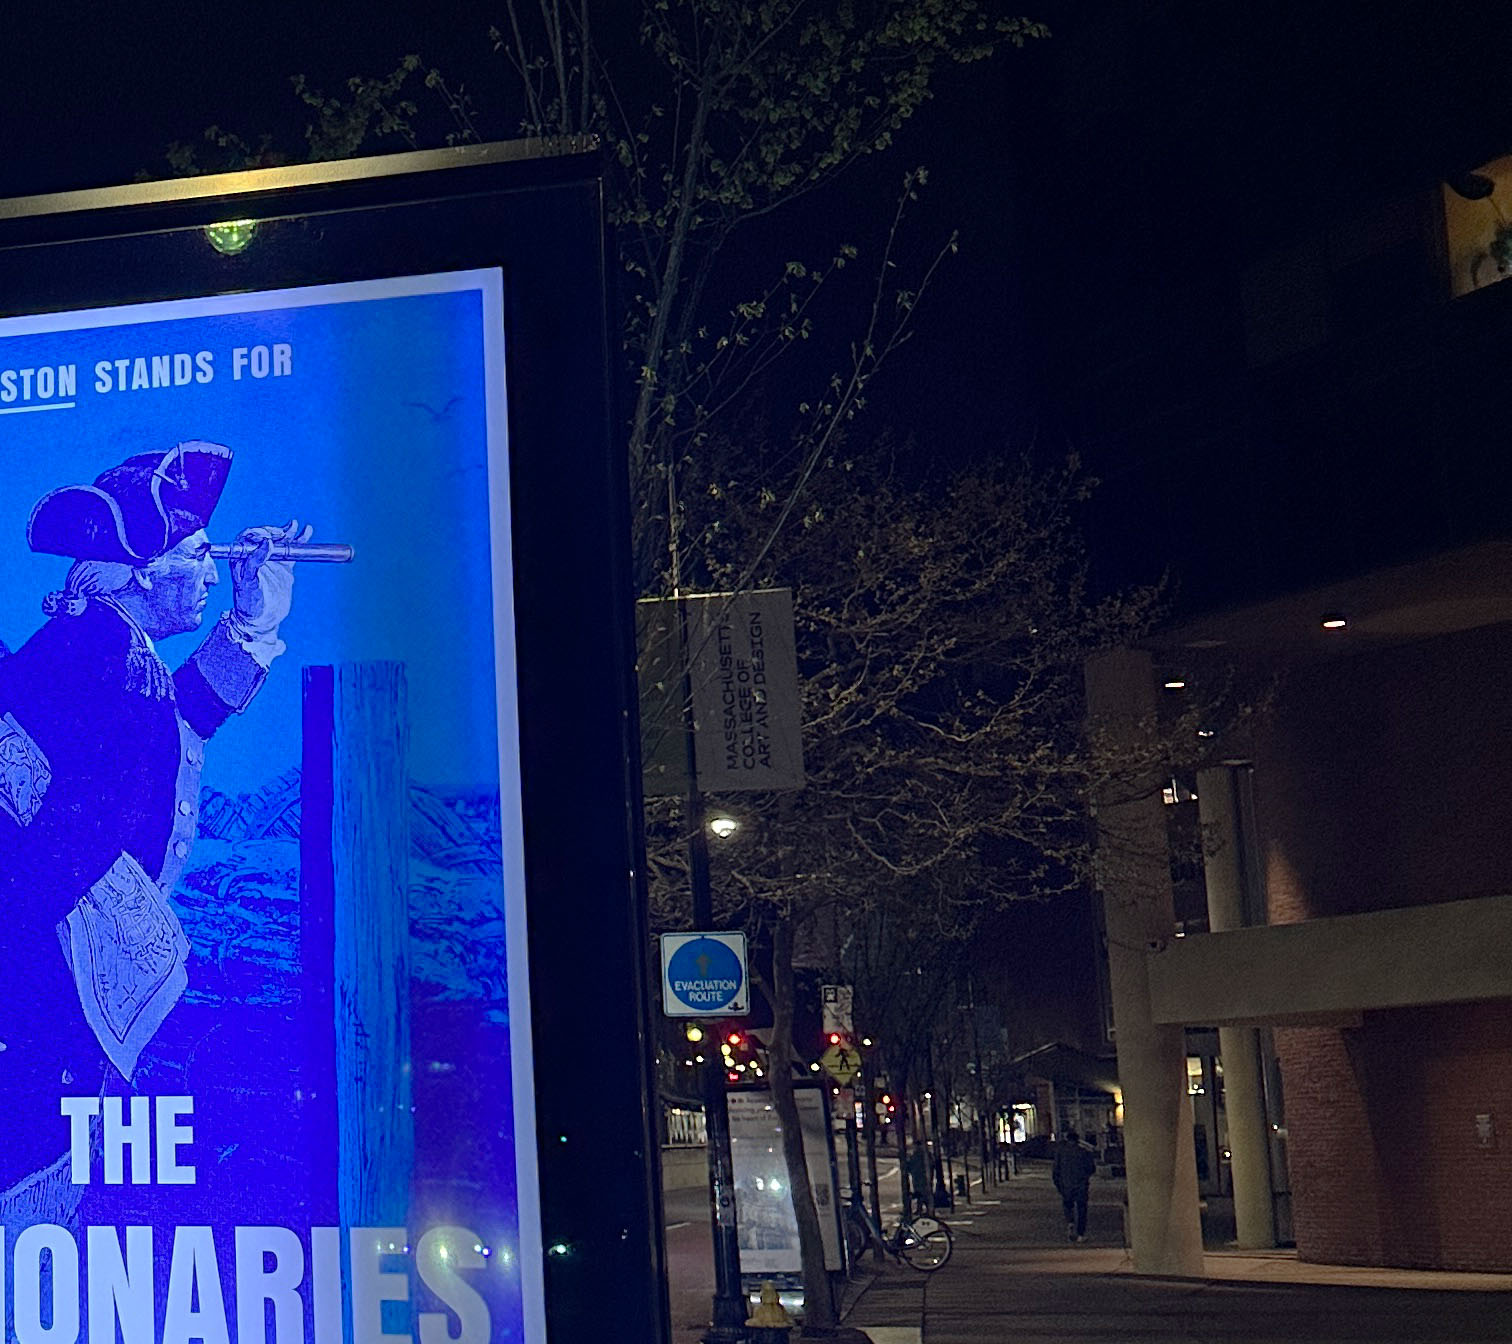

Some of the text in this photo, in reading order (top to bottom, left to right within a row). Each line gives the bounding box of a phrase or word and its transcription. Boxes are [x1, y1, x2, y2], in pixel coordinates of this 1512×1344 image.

[94, 350, 215, 394] STANDS
[232, 343, 293, 381] FOR
[748, 611, 767, 685] DESIGN
[737, 659, 756, 770] COLLEGE OF
[756, 733, 772, 769] ART
[674, 979, 737, 991] EVACUATION
[688, 991, 724, 1002] ROUTE
[60, 1095, 196, 1185] THE
